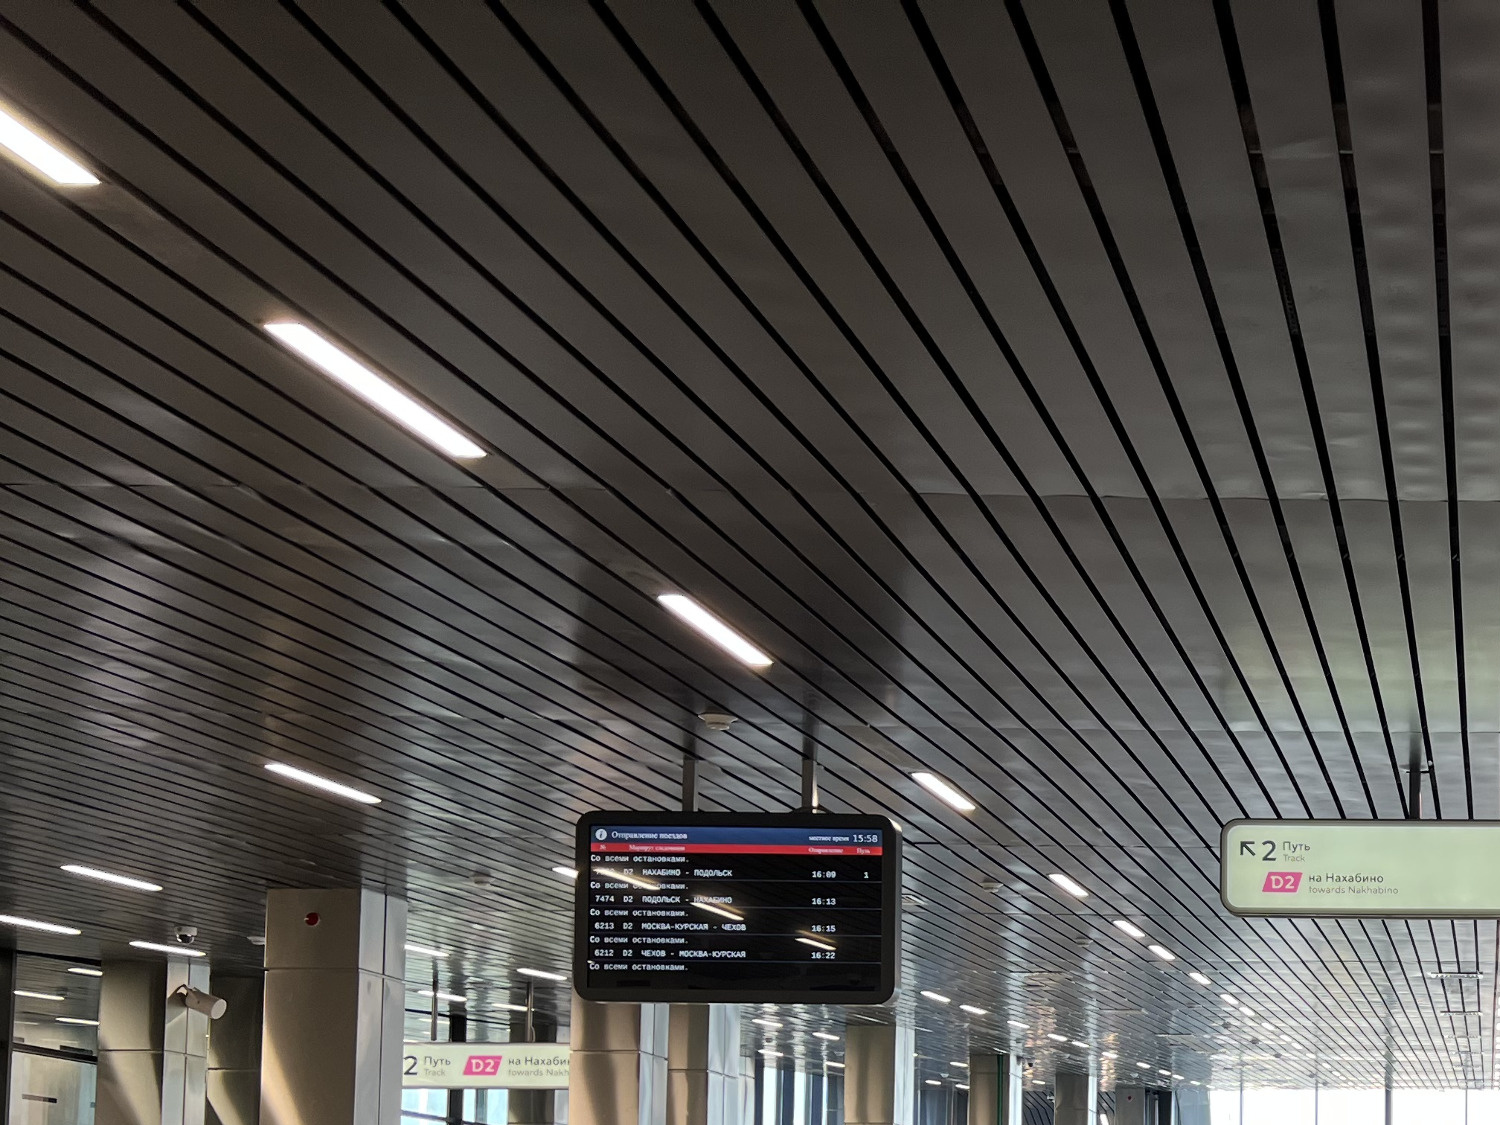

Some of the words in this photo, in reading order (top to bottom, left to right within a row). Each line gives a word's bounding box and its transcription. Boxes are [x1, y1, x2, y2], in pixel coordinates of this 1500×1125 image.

[611, 831, 658, 840] Отправление
[853, 835, 878, 843] 15:58
[1262, 840, 1277, 862] 2
[1282, 841, 1311, 853] Путь
[591, 854, 601, 862] Со
[633, 855, 690, 863] остановками.
[1283, 854, 1306, 862] Track
[694, 869, 733, 877] ПОДОЛЬСК
[1270, 875, 1295, 889] D2
[1308, 874, 1322, 883] на
[1325, 873, 1384, 883] Нахабино
[1308, 886, 1346, 894] towards
[1348, 885, 1399, 895] Nakhabino
[623, 895, 633, 903] D2
[642, 896, 681, 904] ПОДОЛЬСК
[694, 896, 733, 904] НАХАБИНО
[594, 922, 615, 930] 6213
[622, 922, 633, 930] D2
[641, 923, 709, 931] МОСКВА-КУРСКАЯ
[721, 923, 747, 931] ЧЕХОВ
[594, 949, 614, 957] 6212
[679, 950, 746, 958] МОСКВА-КУРСКАЯ
[403, 1055, 418, 1076] 2
[423, 1056, 451, 1067] Путь
[471, 1059, 495, 1073] D2
[424, 1068, 446, 1076] Track
[508, 1068, 543, 1077] towards
